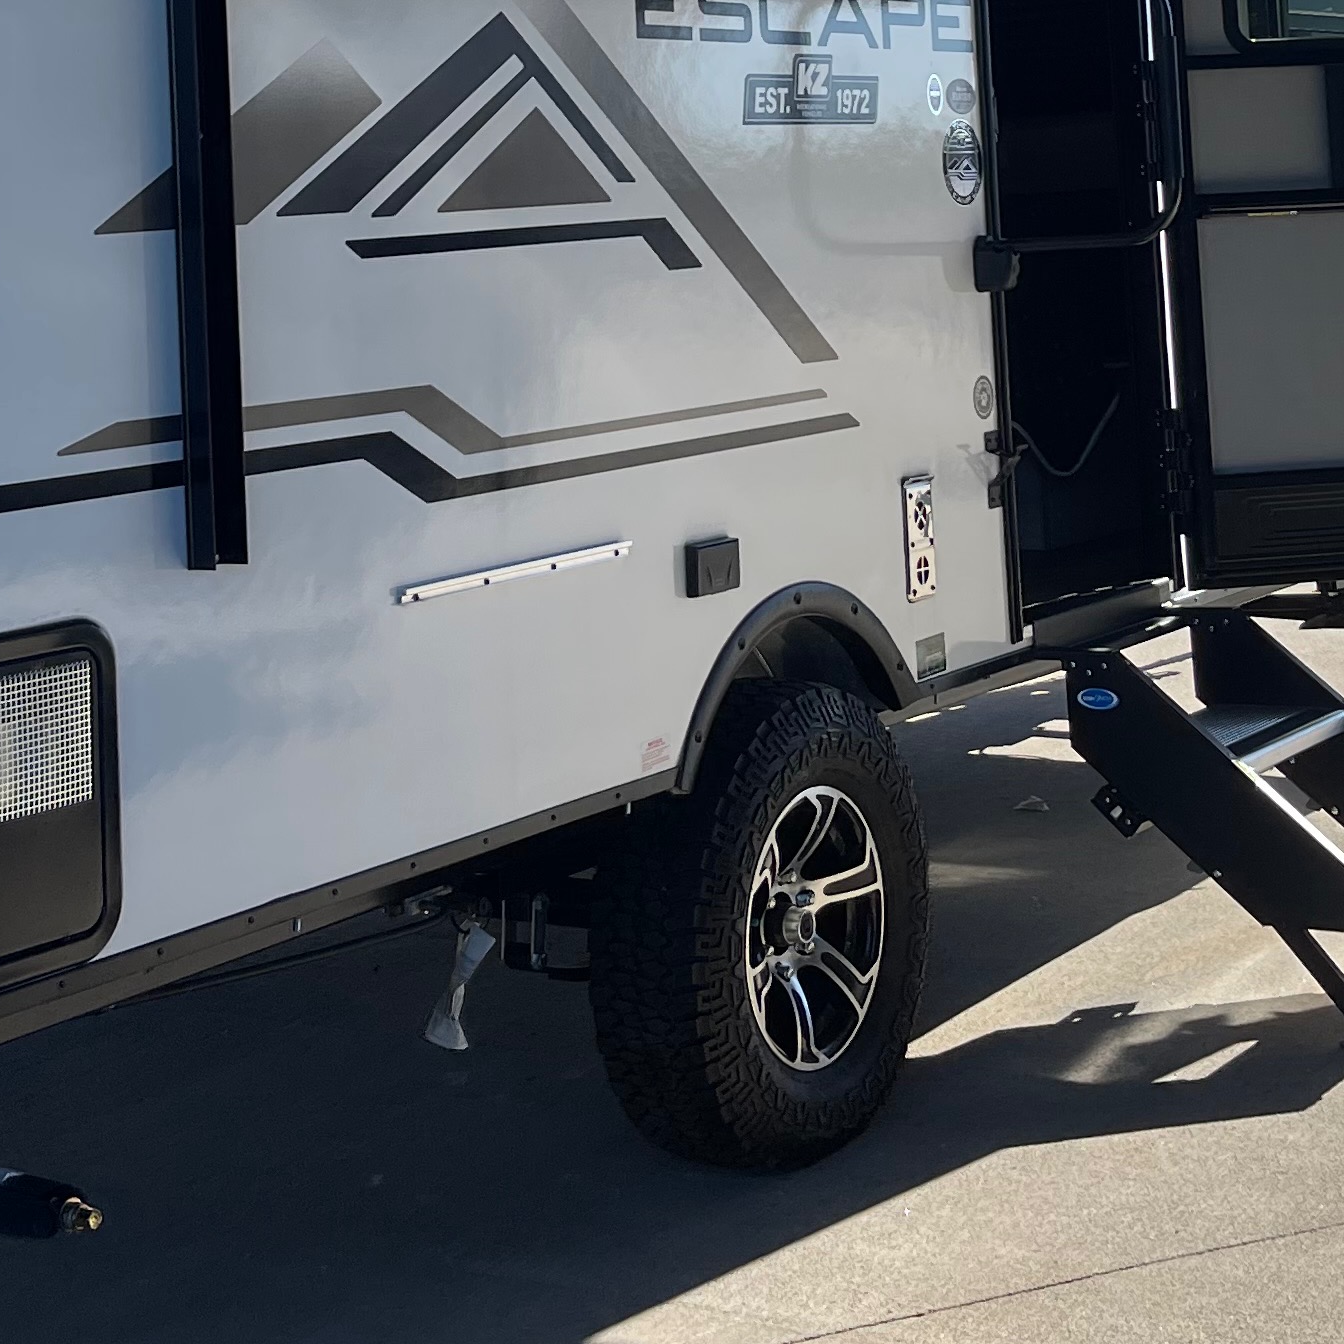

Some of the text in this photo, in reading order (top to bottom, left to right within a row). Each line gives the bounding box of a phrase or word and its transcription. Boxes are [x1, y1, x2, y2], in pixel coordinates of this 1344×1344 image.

[797, 62, 830, 95] KZ
[754, 86, 792, 114] EST.
[836, 88, 870, 114] 1972
